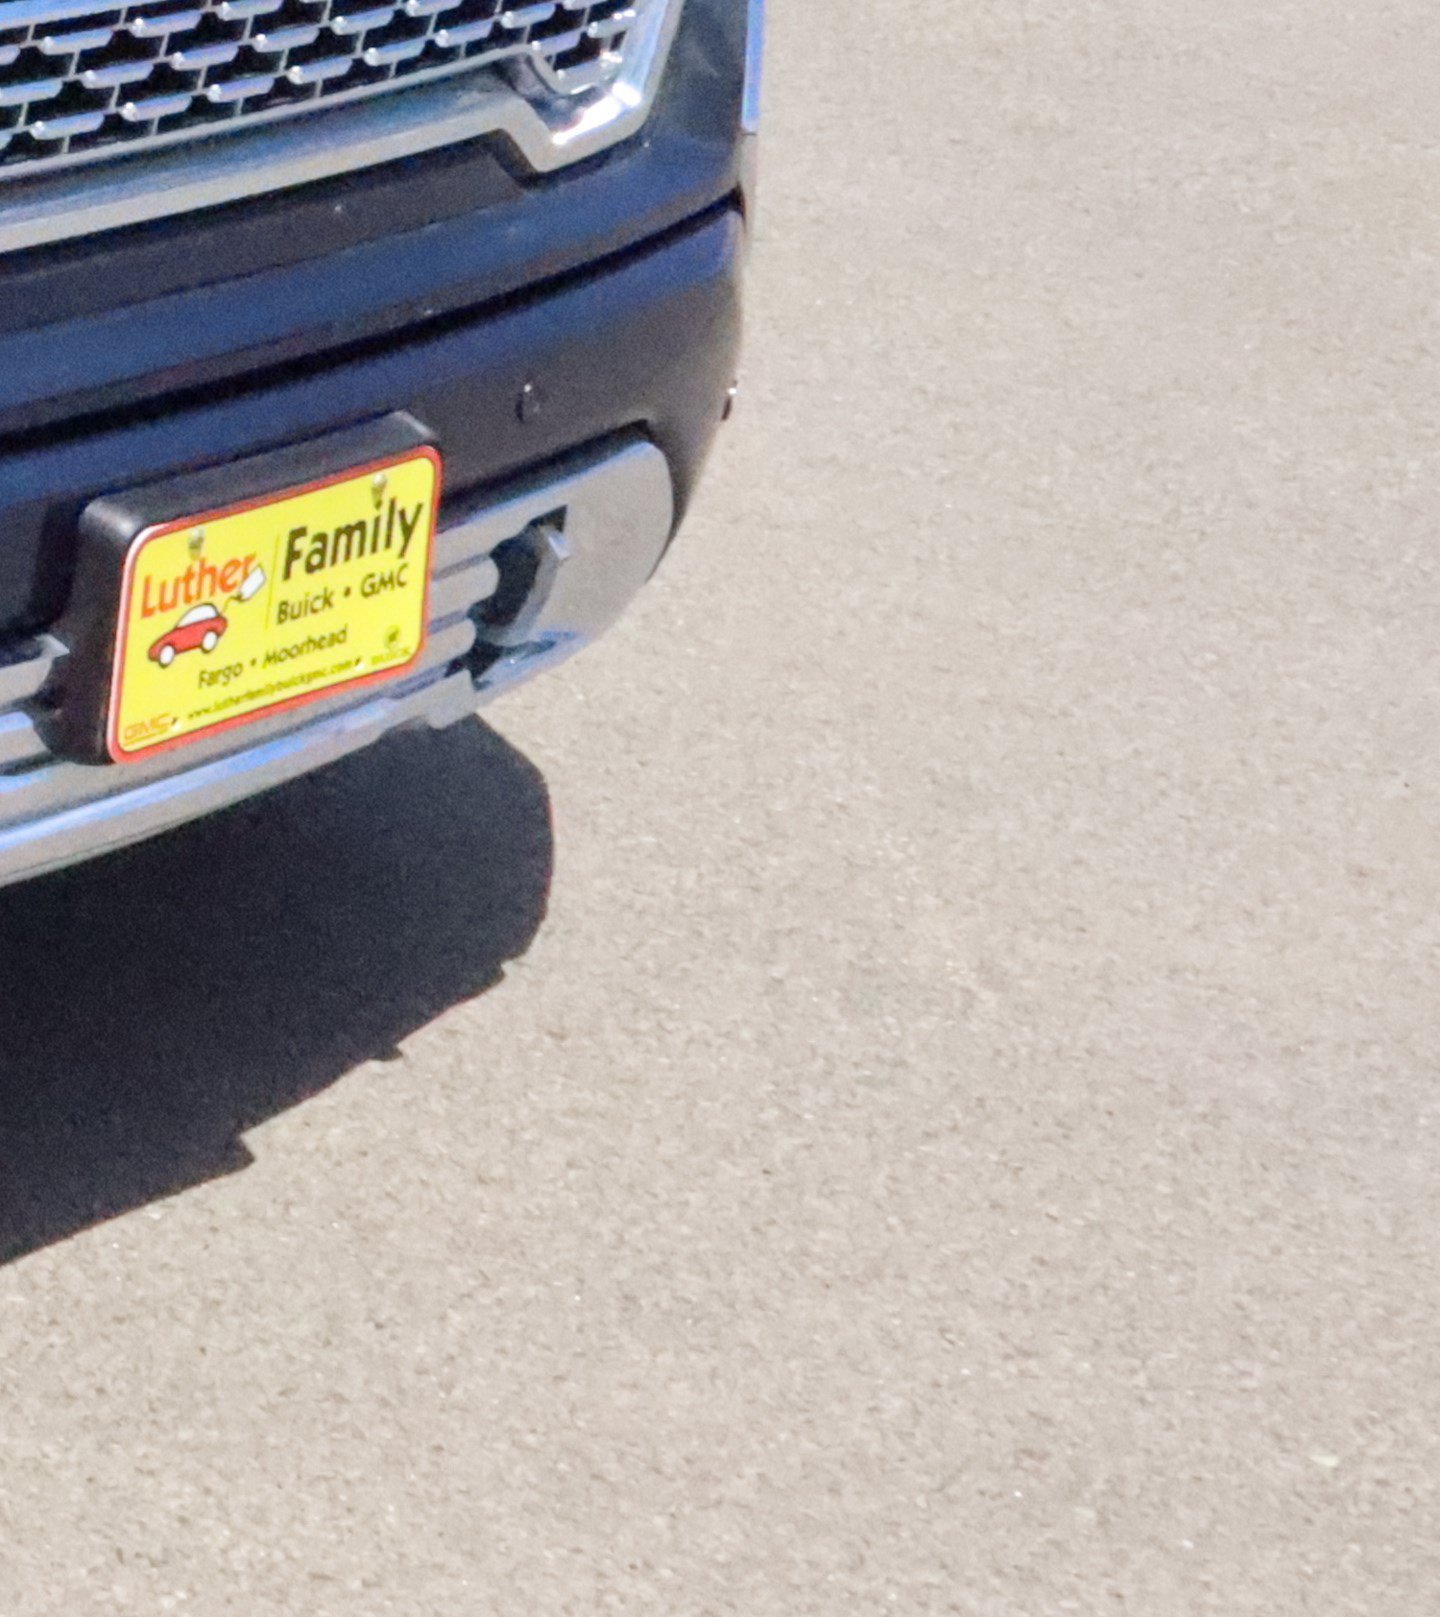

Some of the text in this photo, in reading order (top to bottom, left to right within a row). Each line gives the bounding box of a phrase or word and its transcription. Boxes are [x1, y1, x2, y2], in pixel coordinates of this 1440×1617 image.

[282, 496, 423, 581] Family
[140, 550, 256, 618] Luther
[276, 563, 409, 625] Buick GMC
[198, 624, 349, 689] Fargo Moorhead
